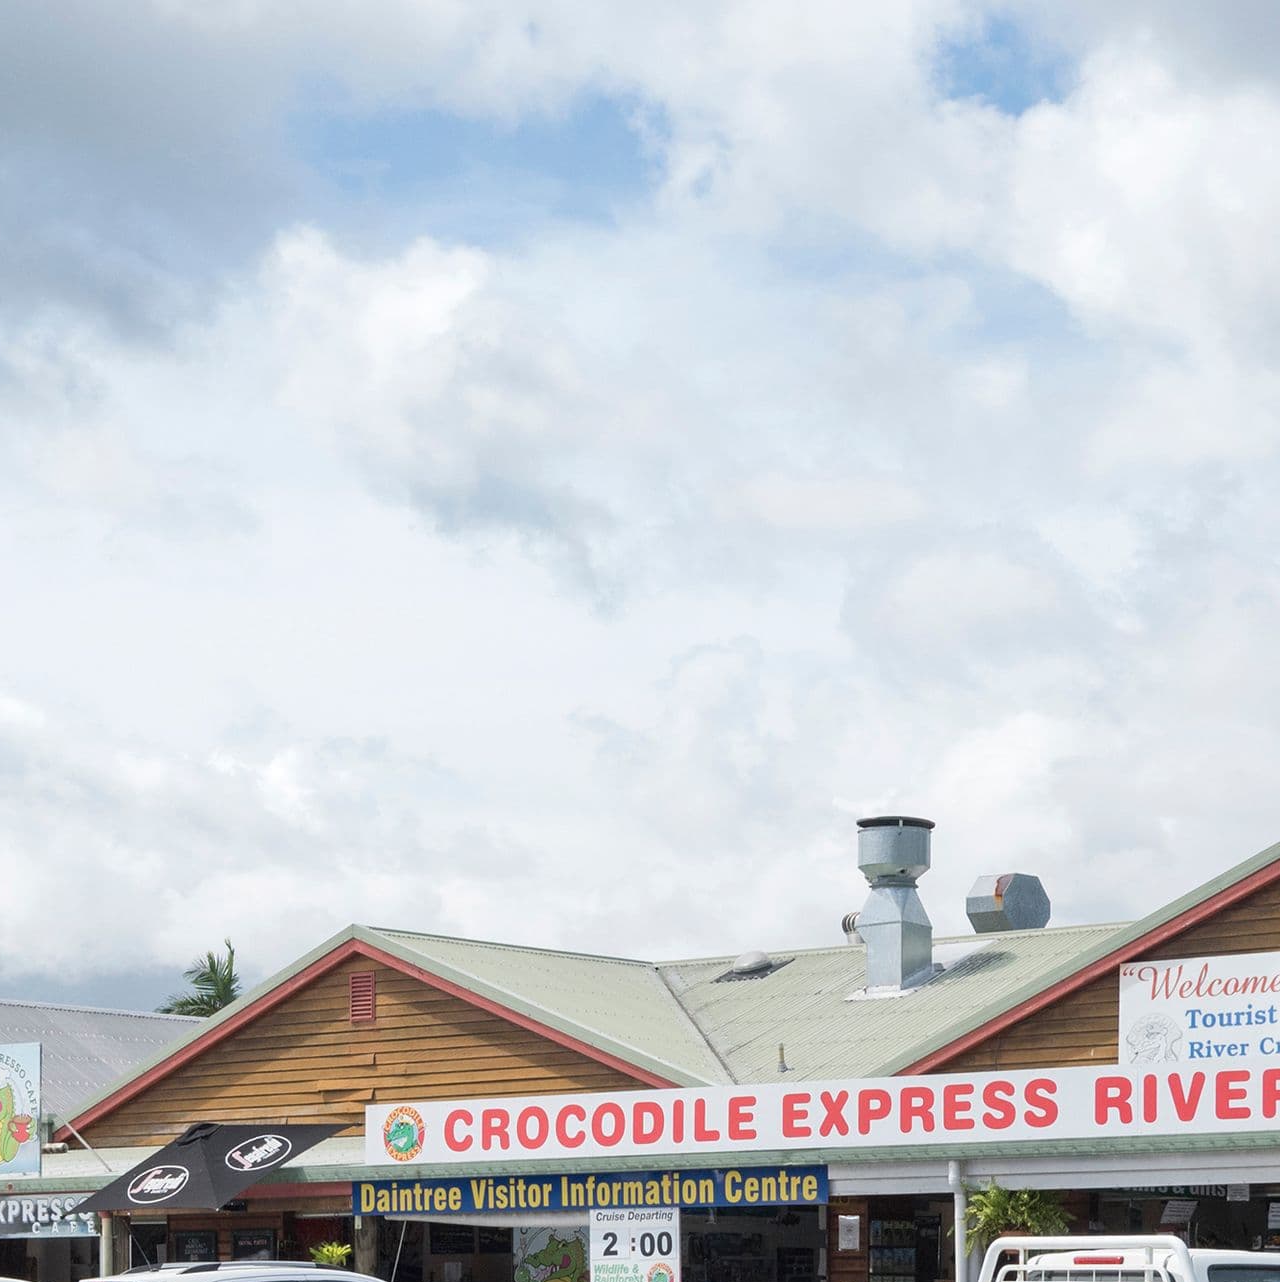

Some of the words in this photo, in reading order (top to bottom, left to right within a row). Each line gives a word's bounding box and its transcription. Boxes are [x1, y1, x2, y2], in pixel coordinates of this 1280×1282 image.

[1185, 1003, 1277, 1029] Tourist
[1188, 1040, 1249, 1059] River
[24, 1080, 38, 1114] CAFE
[444, 1096, 757, 1152] CROCODILE
[782, 1078, 1058, 1139] EXPRESS
[360, 1182, 462, 1213] Daintree
[470, 1177, 552, 1210] Visitor
[560, 1172, 714, 1207] Information
[724, 1170, 818, 1203] Centre
[596, 1211, 625, 1222] Cruise
[628, 1211, 673, 1223] Departing
[594, 1263, 629, 1274] Wildlife
[632, 1263, 639, 1274] &
